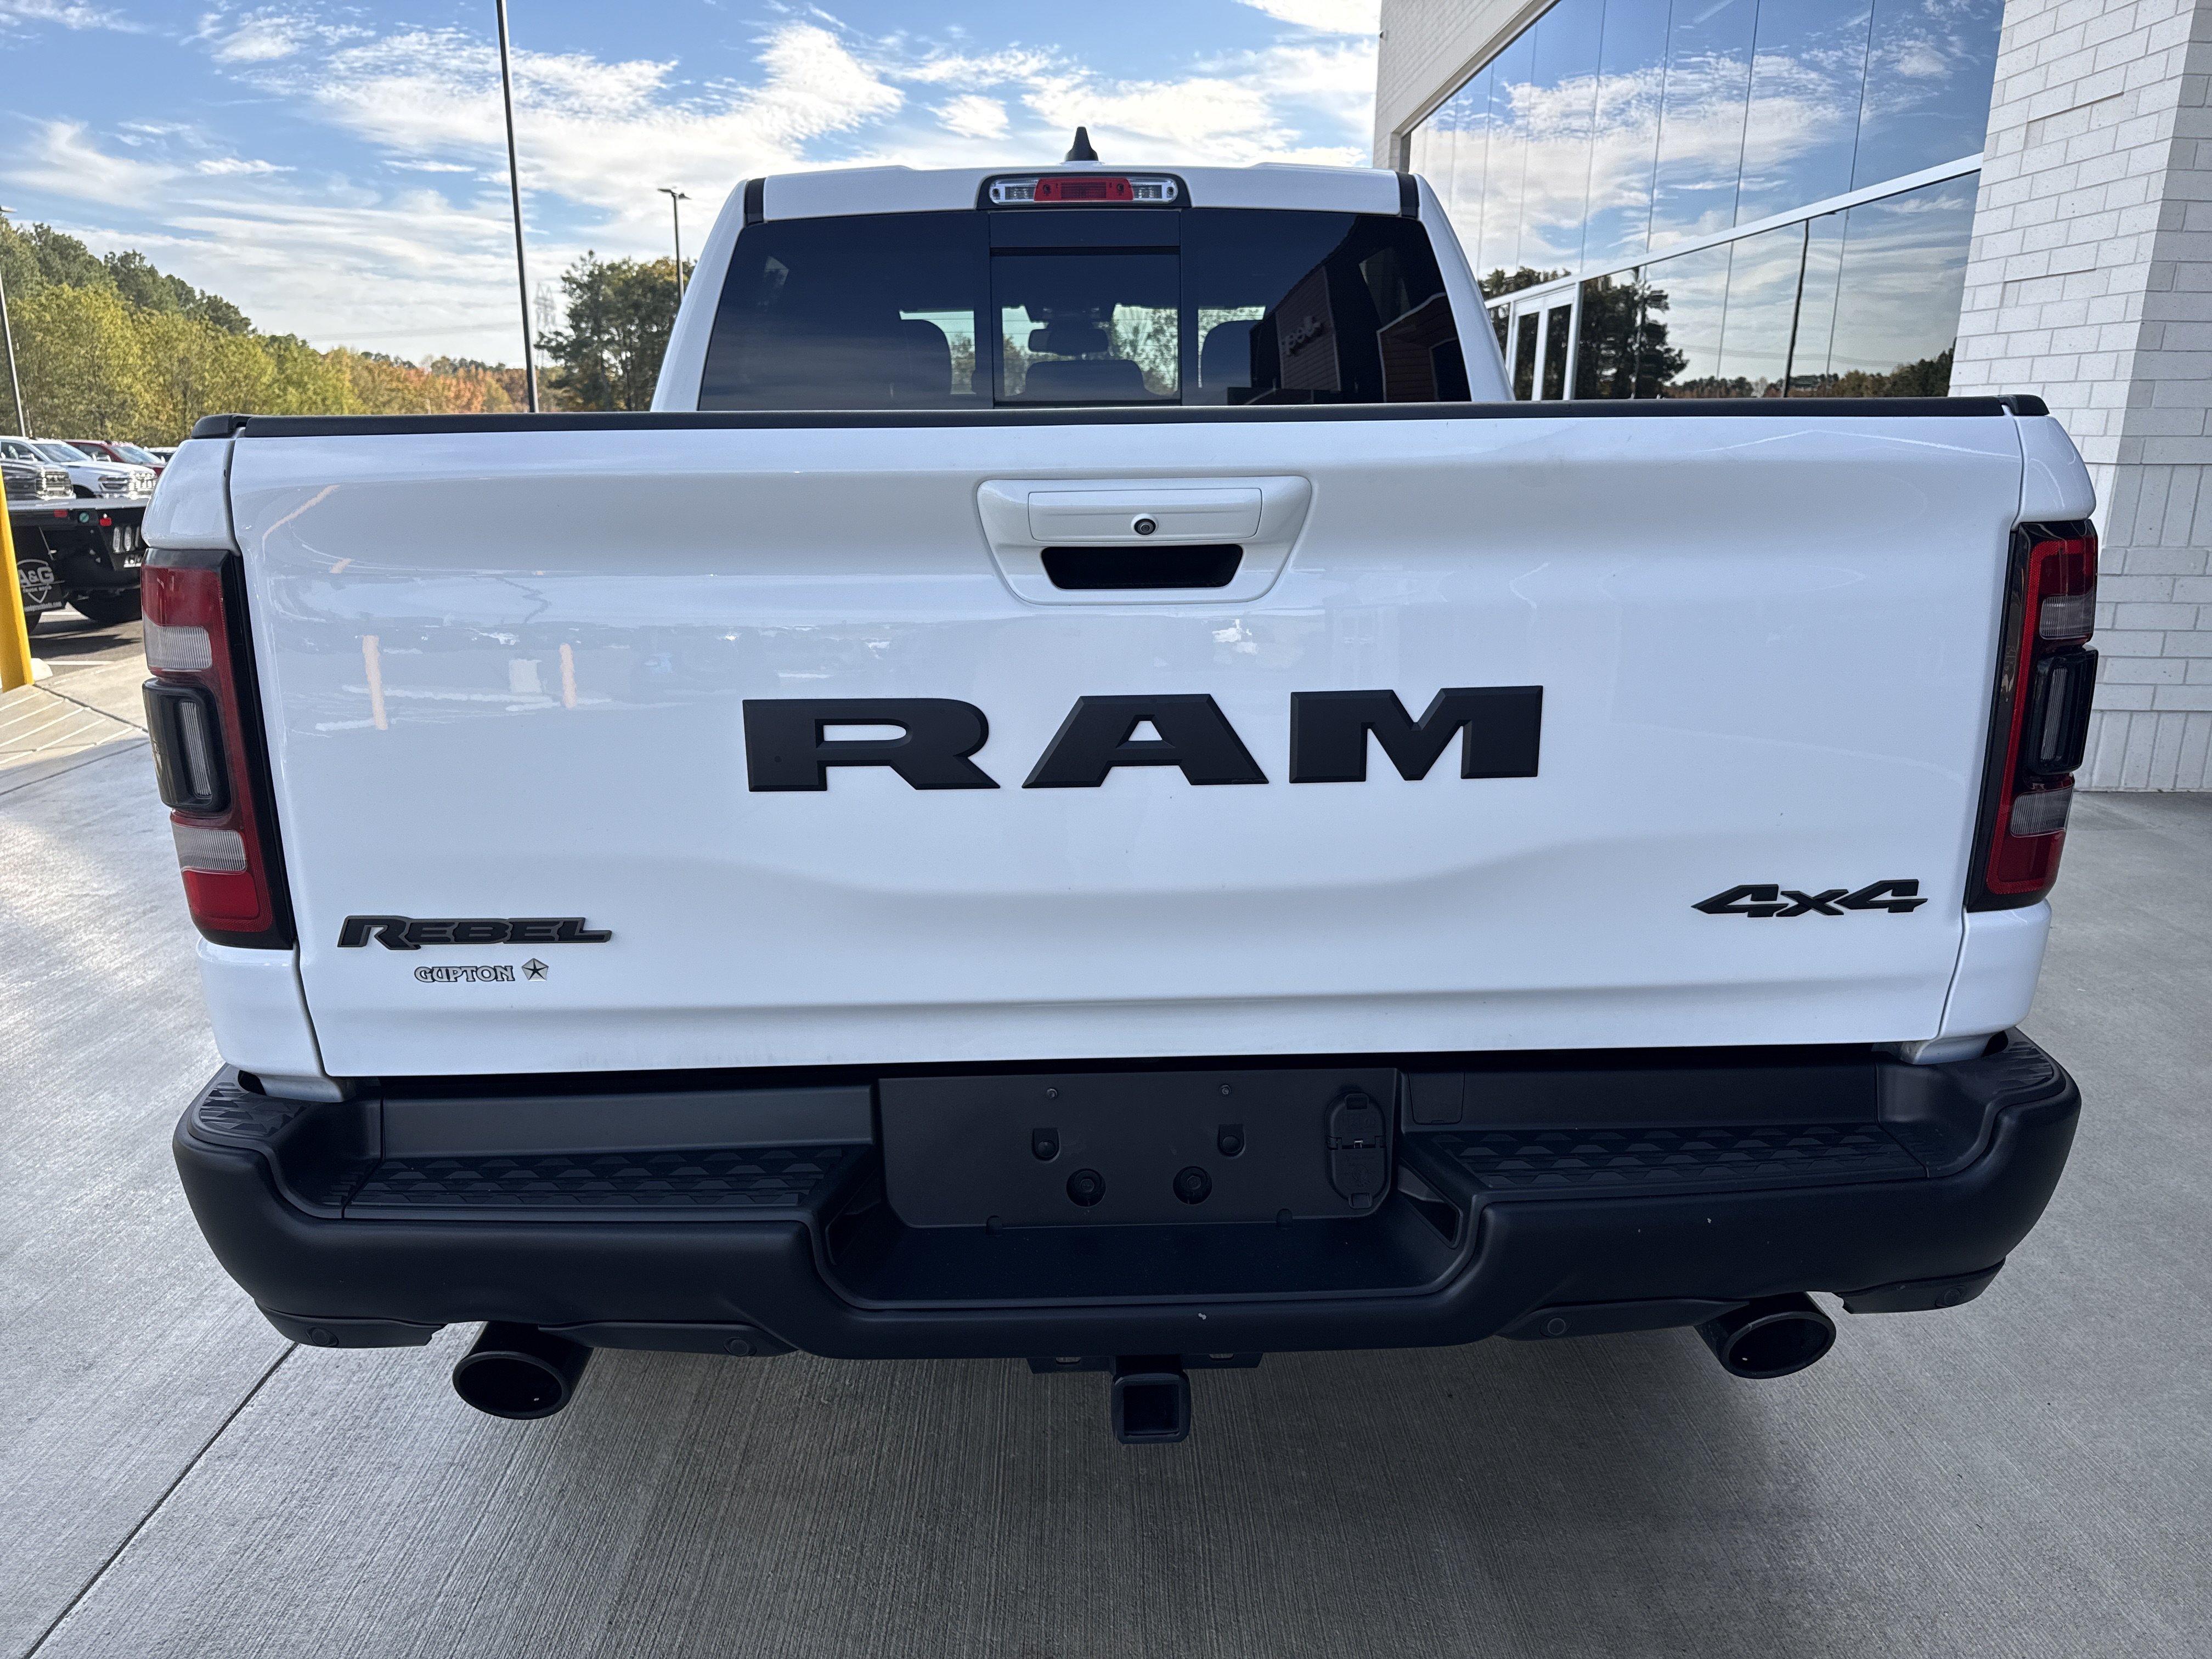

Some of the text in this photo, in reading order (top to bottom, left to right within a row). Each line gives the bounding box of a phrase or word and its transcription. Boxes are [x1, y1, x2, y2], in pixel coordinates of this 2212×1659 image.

[742, 686, 1543, 792] RAM
[1691, 879, 1927, 917] 4x4
[337, 915, 612, 950] REBEL
[414, 966, 515, 983] GUPTON
